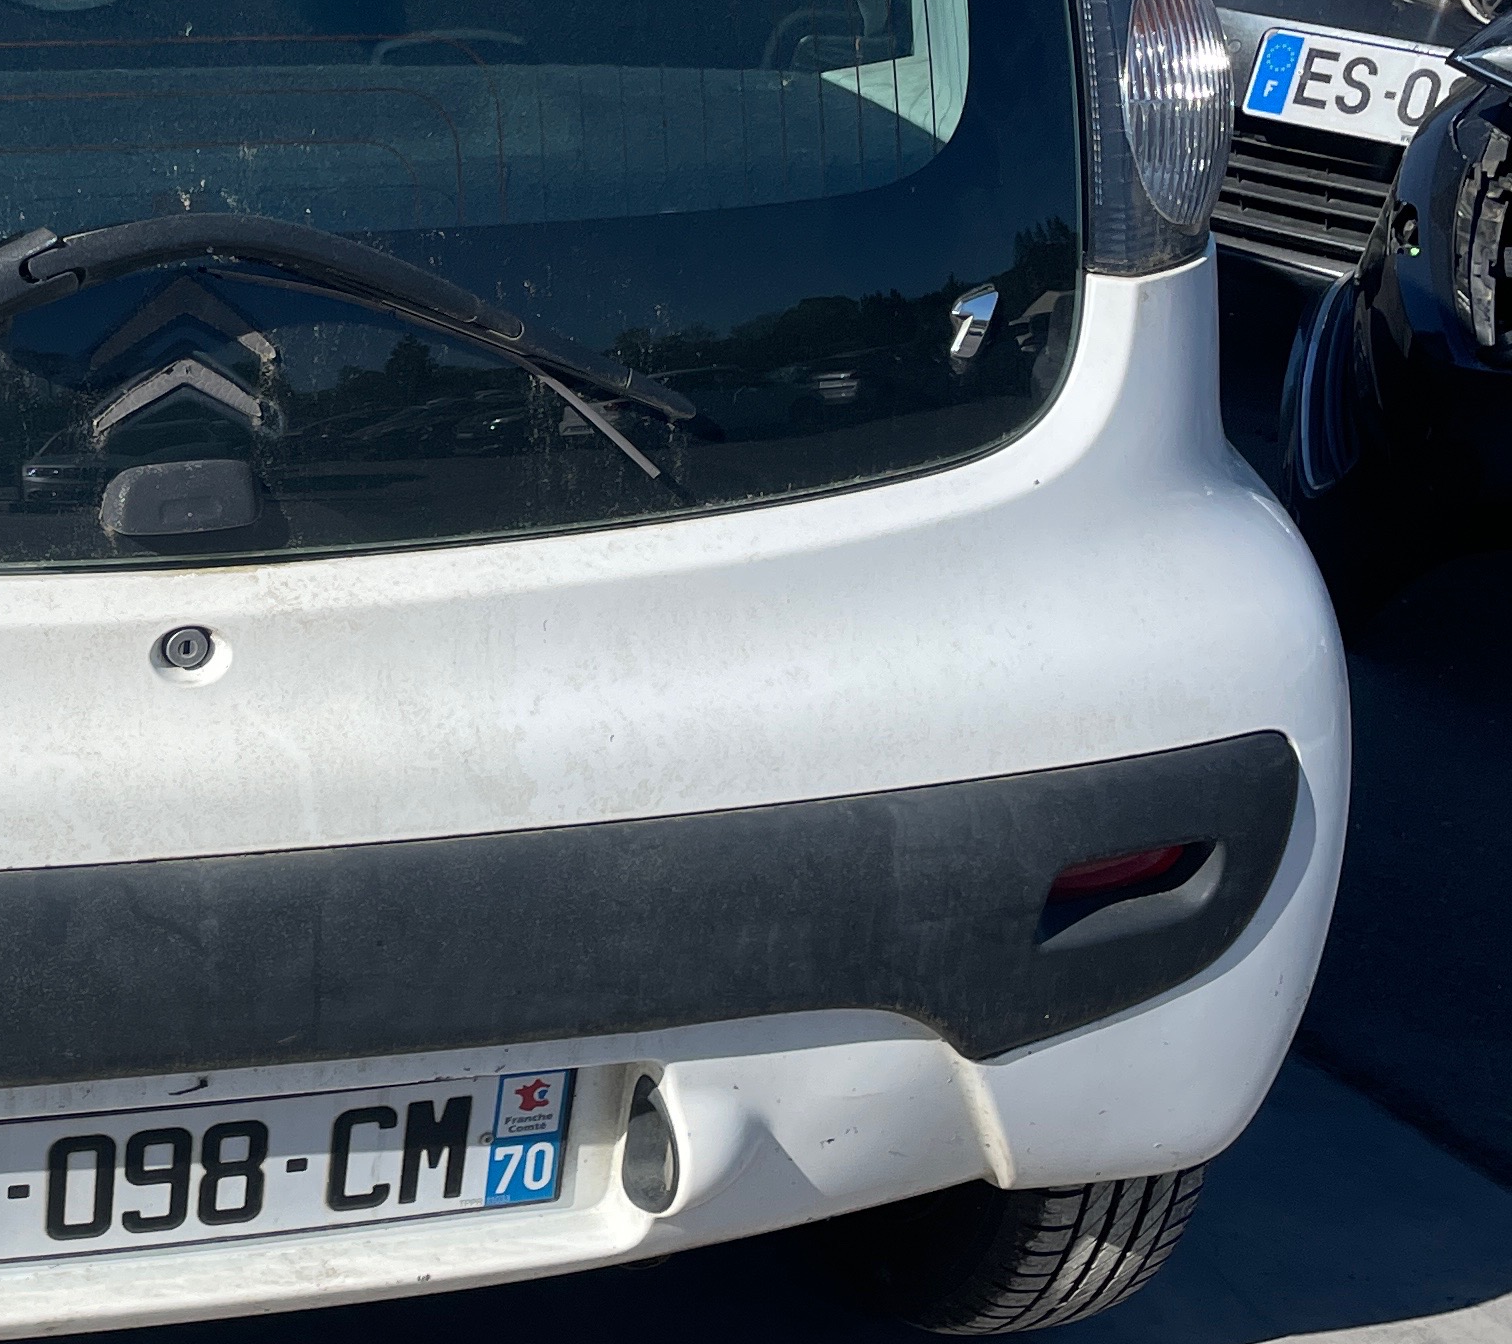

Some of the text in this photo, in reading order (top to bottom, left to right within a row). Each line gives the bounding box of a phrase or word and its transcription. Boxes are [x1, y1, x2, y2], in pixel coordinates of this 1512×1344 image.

[1263, 80, 1279, 98] F
[1292, 47, 1468, 128] ES-0
[504, 1112, 554, 1126] Franche
[508, 1122, 548, 1134] Comté
[494, 1141, 555, 1195] 70
